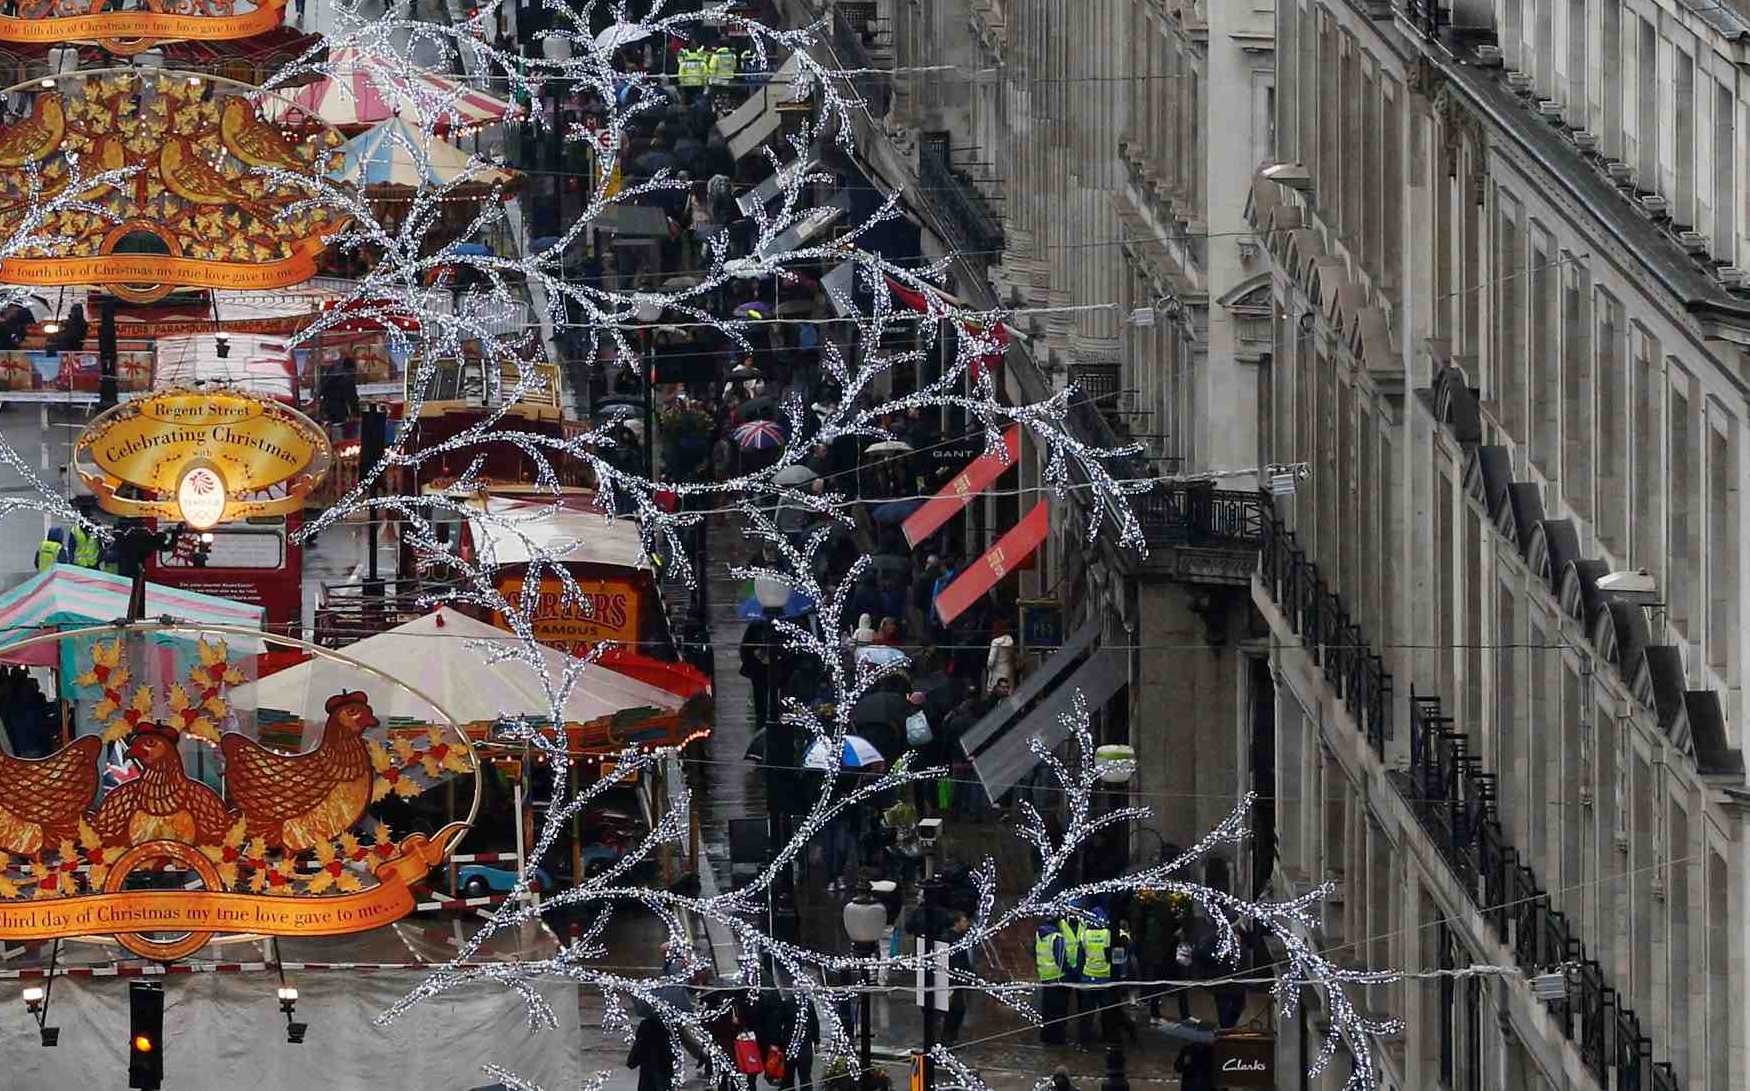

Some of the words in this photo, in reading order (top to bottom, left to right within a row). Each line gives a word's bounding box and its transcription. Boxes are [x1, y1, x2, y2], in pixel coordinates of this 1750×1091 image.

[17, 266, 51, 278] fourth
[56, 266, 75, 279] day
[94, 264, 152, 275] Christmas
[156, 267, 172, 279] my
[205, 267, 230, 281] love
[233, 271, 261, 284] gave
[154, 403, 203, 419] Regent
[207, 403, 250, 416] Street
[105, 427, 206, 463] Celebrating
[212, 426, 299, 466] Christmas
[932, 450, 974, 458] GANT
[42, 910, 71, 929] day
[76, 907, 92, 922] of
[97, 905, 180, 922] Christmas
[187, 908, 210, 924] my
[217, 906, 250, 920] true
[255, 905, 290, 923] love
[294, 910, 331, 927] gave
[337, 907, 353, 923] to
[1222, 1057, 1266, 1071] Clarks
